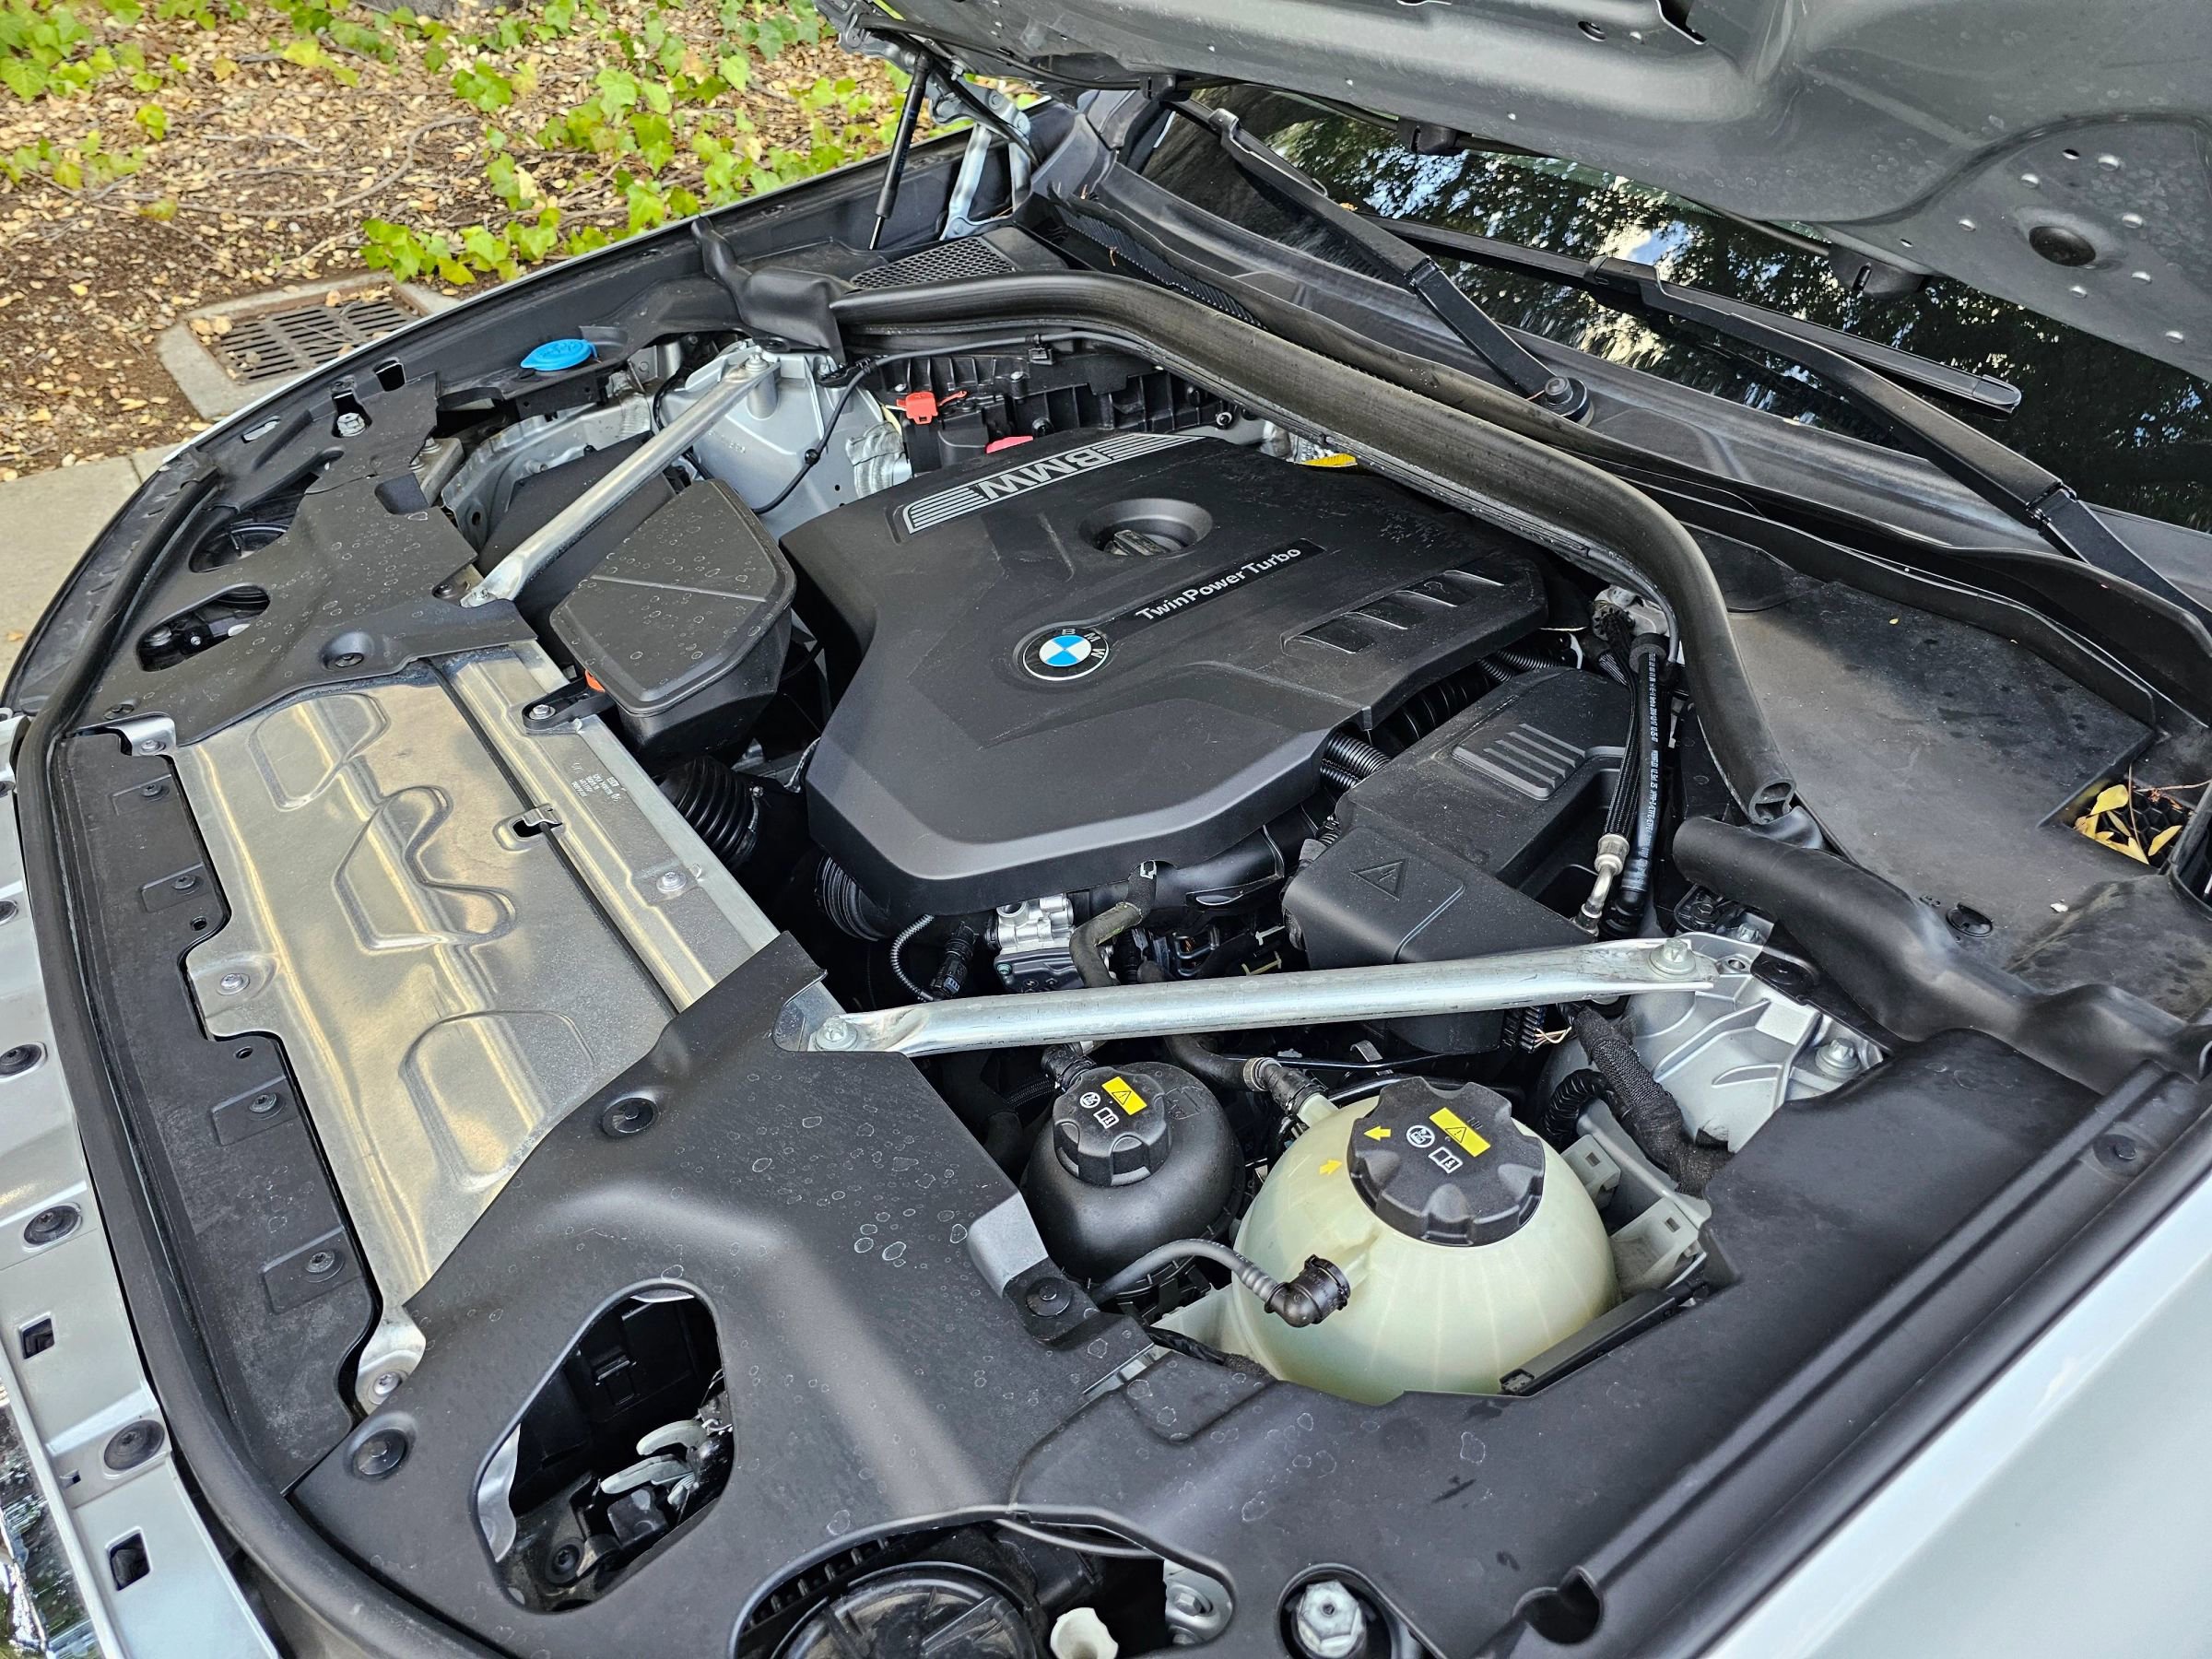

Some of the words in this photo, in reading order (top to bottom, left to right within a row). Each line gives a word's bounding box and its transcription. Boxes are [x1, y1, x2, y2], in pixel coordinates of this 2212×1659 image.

[978, 448, 1112, 500] BMW
[1135, 571, 1246, 621] TwinPower
[1241, 547, 1301, 575] Turbo
[1061, 628, 1106, 659] BMW
